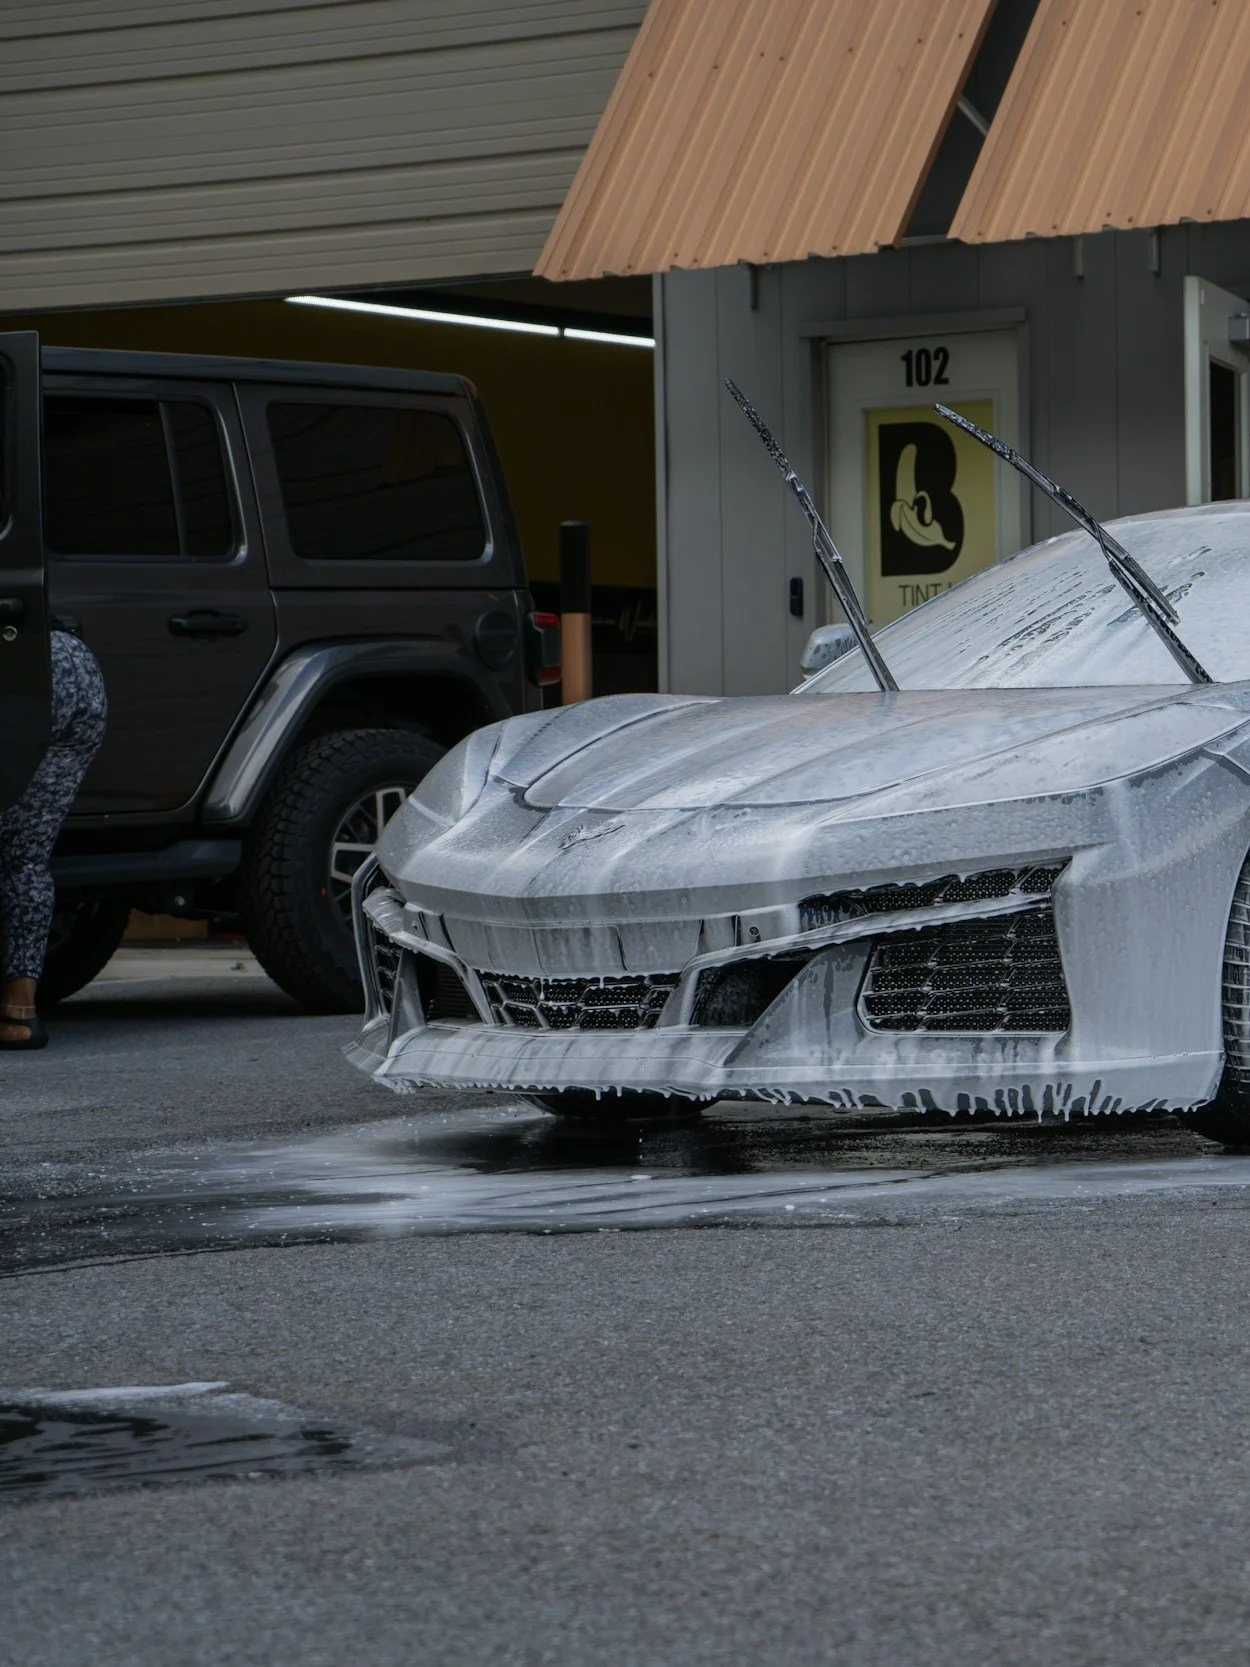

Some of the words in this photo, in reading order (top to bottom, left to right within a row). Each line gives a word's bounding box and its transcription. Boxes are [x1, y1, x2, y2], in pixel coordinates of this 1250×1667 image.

[901, 347, 949, 386] 102
[878, 421, 965, 577] B
[898, 583, 942, 606] TINT
